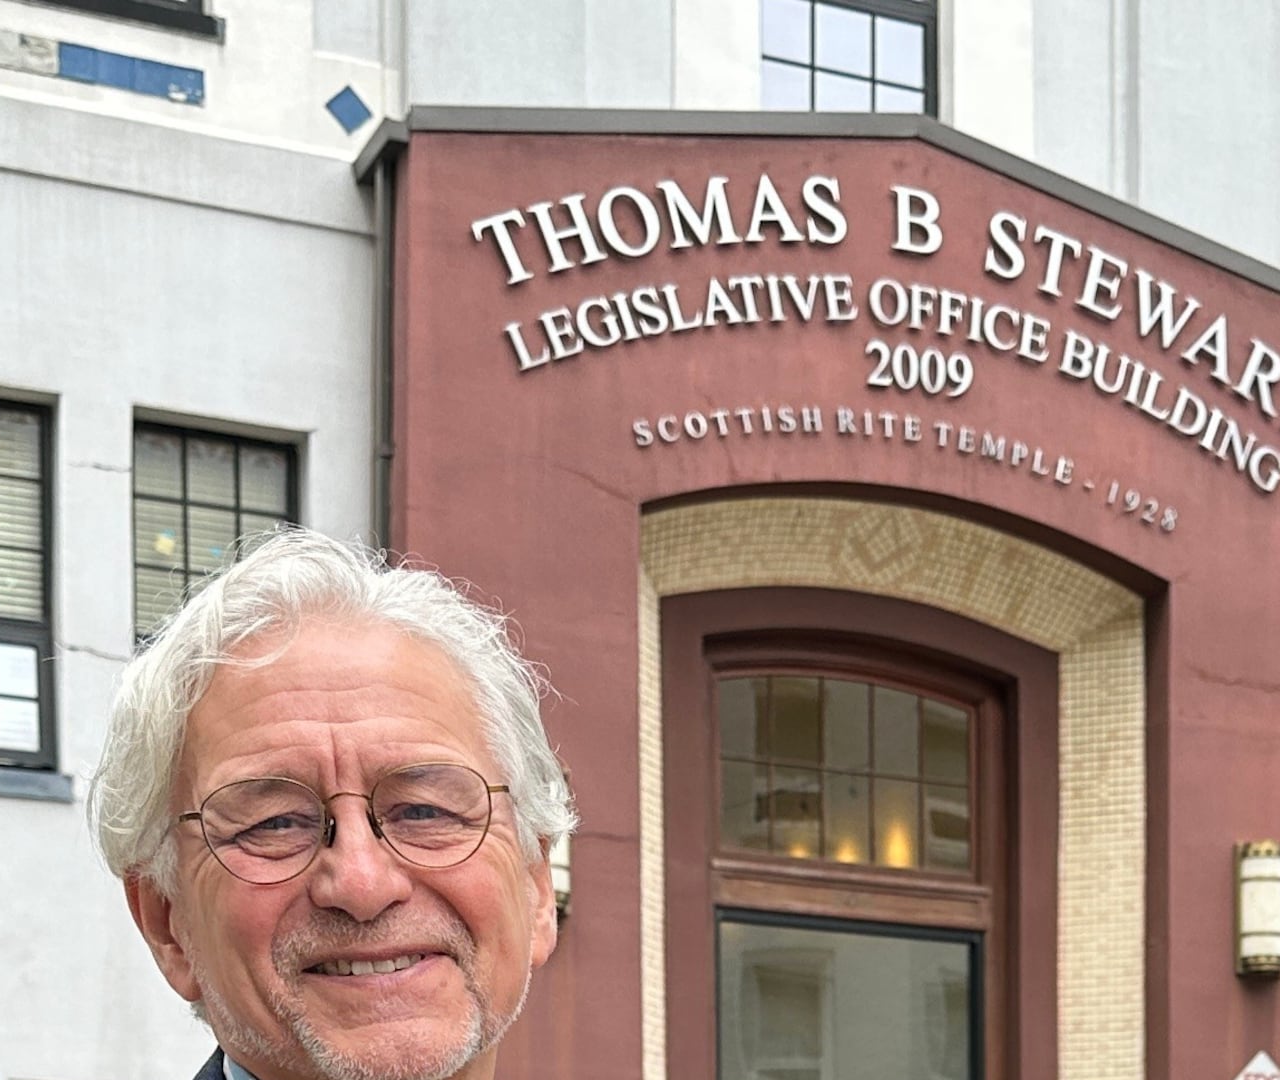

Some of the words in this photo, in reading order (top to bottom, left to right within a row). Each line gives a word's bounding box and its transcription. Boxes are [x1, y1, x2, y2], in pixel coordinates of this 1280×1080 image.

[470, 173, 848, 286] THOMAS
[889, 184, 944, 255] B
[504, 273, 859, 372] LEGISLATIVE
[869, 278, 1052, 363] OFFICE
[864, 339, 974, 398] 2009
[631, 403, 823, 447] SCOTTISH
[836, 405, 922, 441] RITE
[933, 419, 1075, 485] TEMPLE
[1107, 479, 1179, 532] 1928
